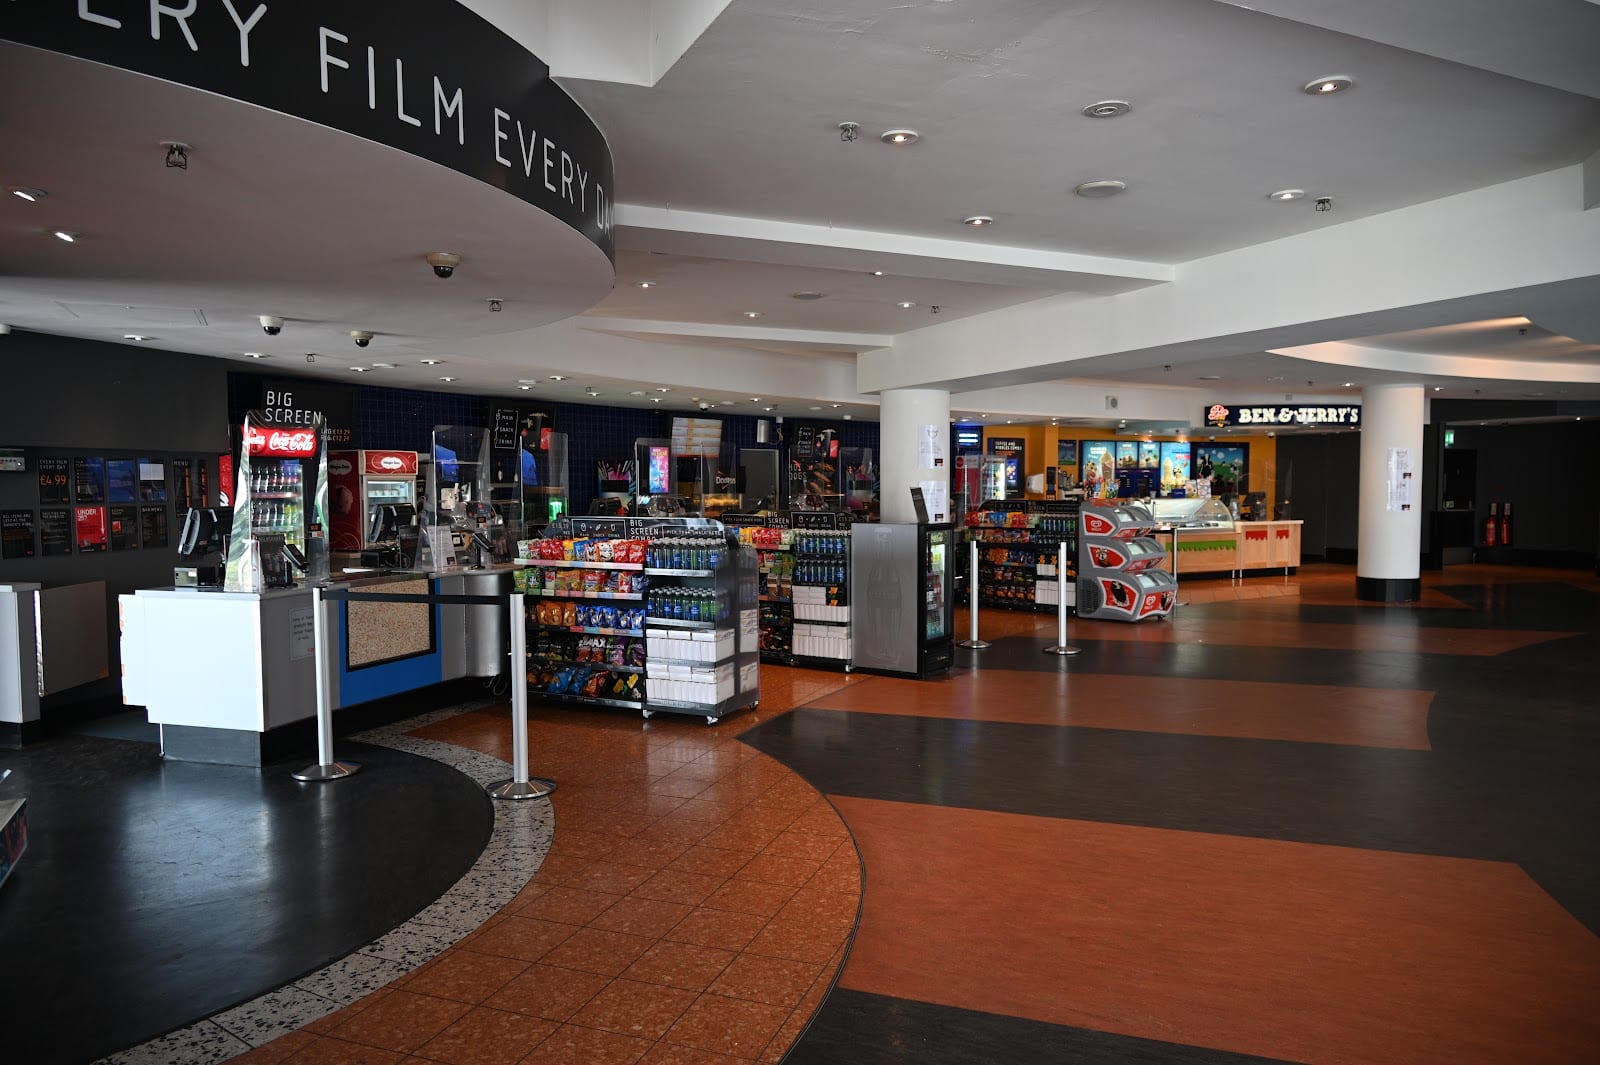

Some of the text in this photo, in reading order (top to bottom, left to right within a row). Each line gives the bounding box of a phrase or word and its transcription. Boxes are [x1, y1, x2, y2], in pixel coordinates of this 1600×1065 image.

[319, 26, 465, 146] FILM
[494, 107, 588, 213] EVERY
[596, 183, 613, 243] DA
[266, 390, 293, 407] BIG
[264, 407, 322, 425] SCREEN
[1238, 406, 1358, 424] BEN & JERRY'S
[715, 476, 737, 485] Doritos
[77, 508, 97, 516] UNDER
[629, 519, 643, 527] BIG
[630, 527, 659, 535] SCREEN
